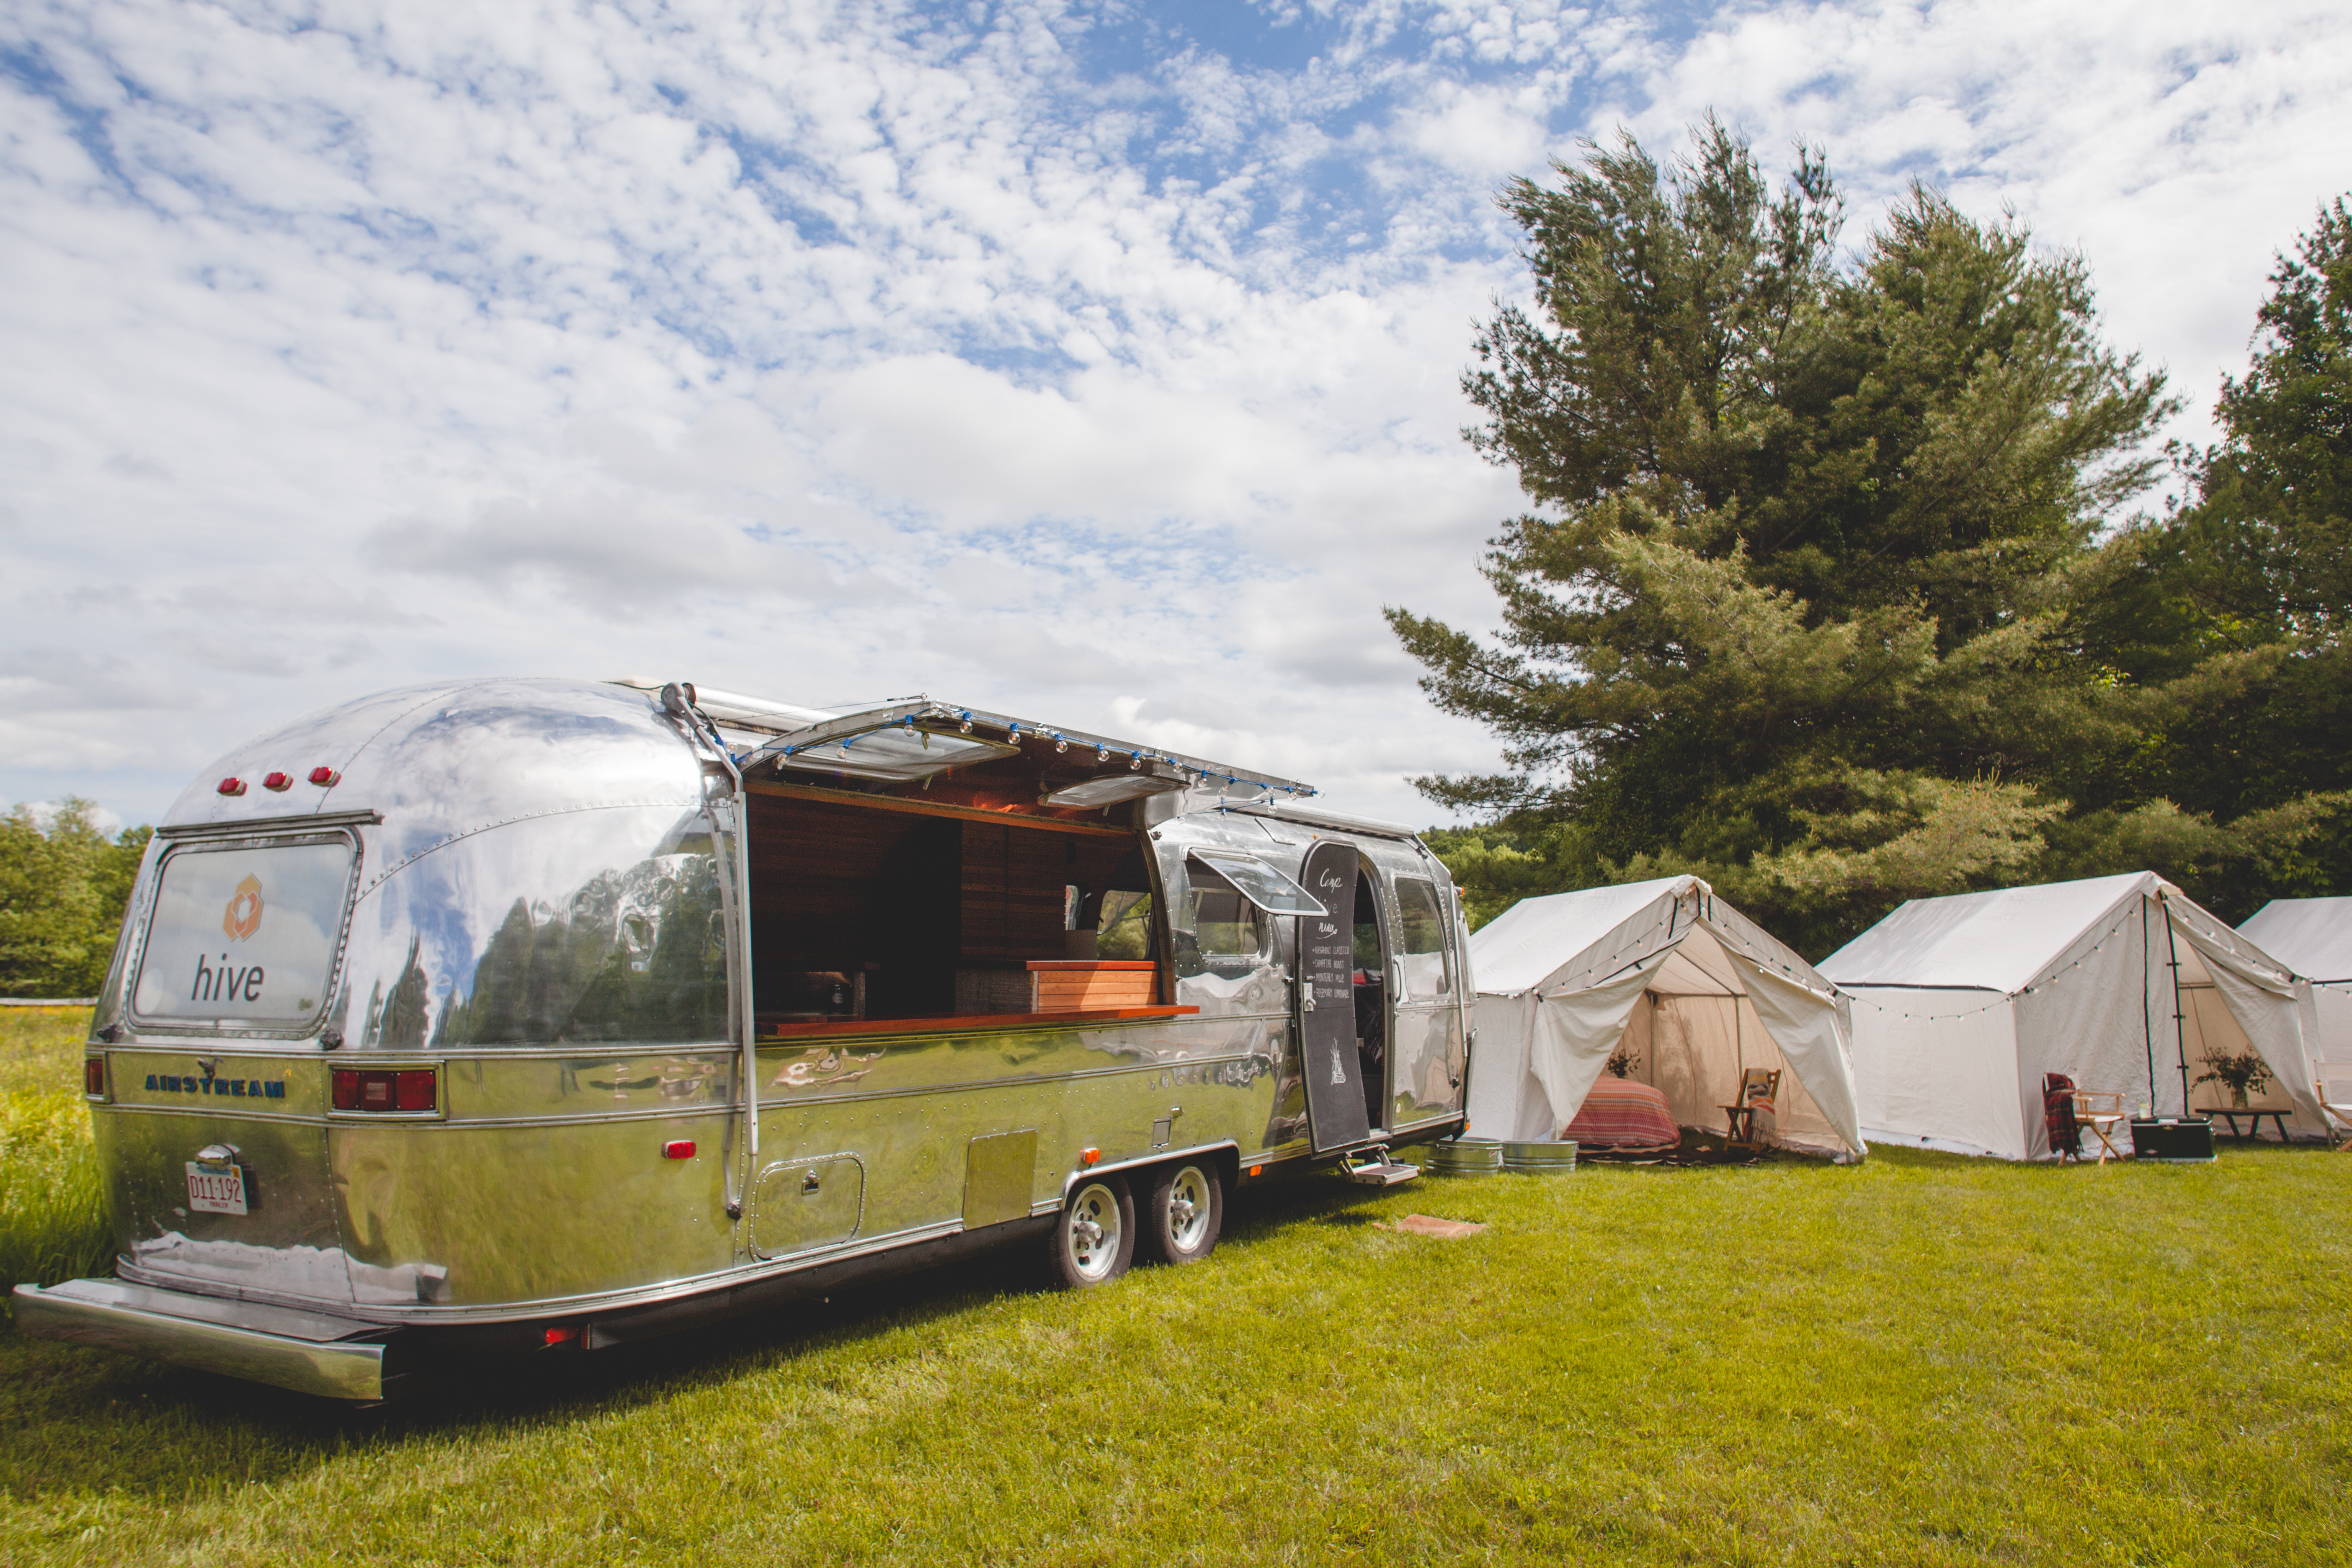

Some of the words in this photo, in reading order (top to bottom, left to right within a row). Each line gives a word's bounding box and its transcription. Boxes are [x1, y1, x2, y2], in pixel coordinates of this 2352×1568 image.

[1320, 868, 1343, 893] Camp
[191, 952, 265, 1002] hive
[145, 1074, 286, 1099] AIRSTREAM
